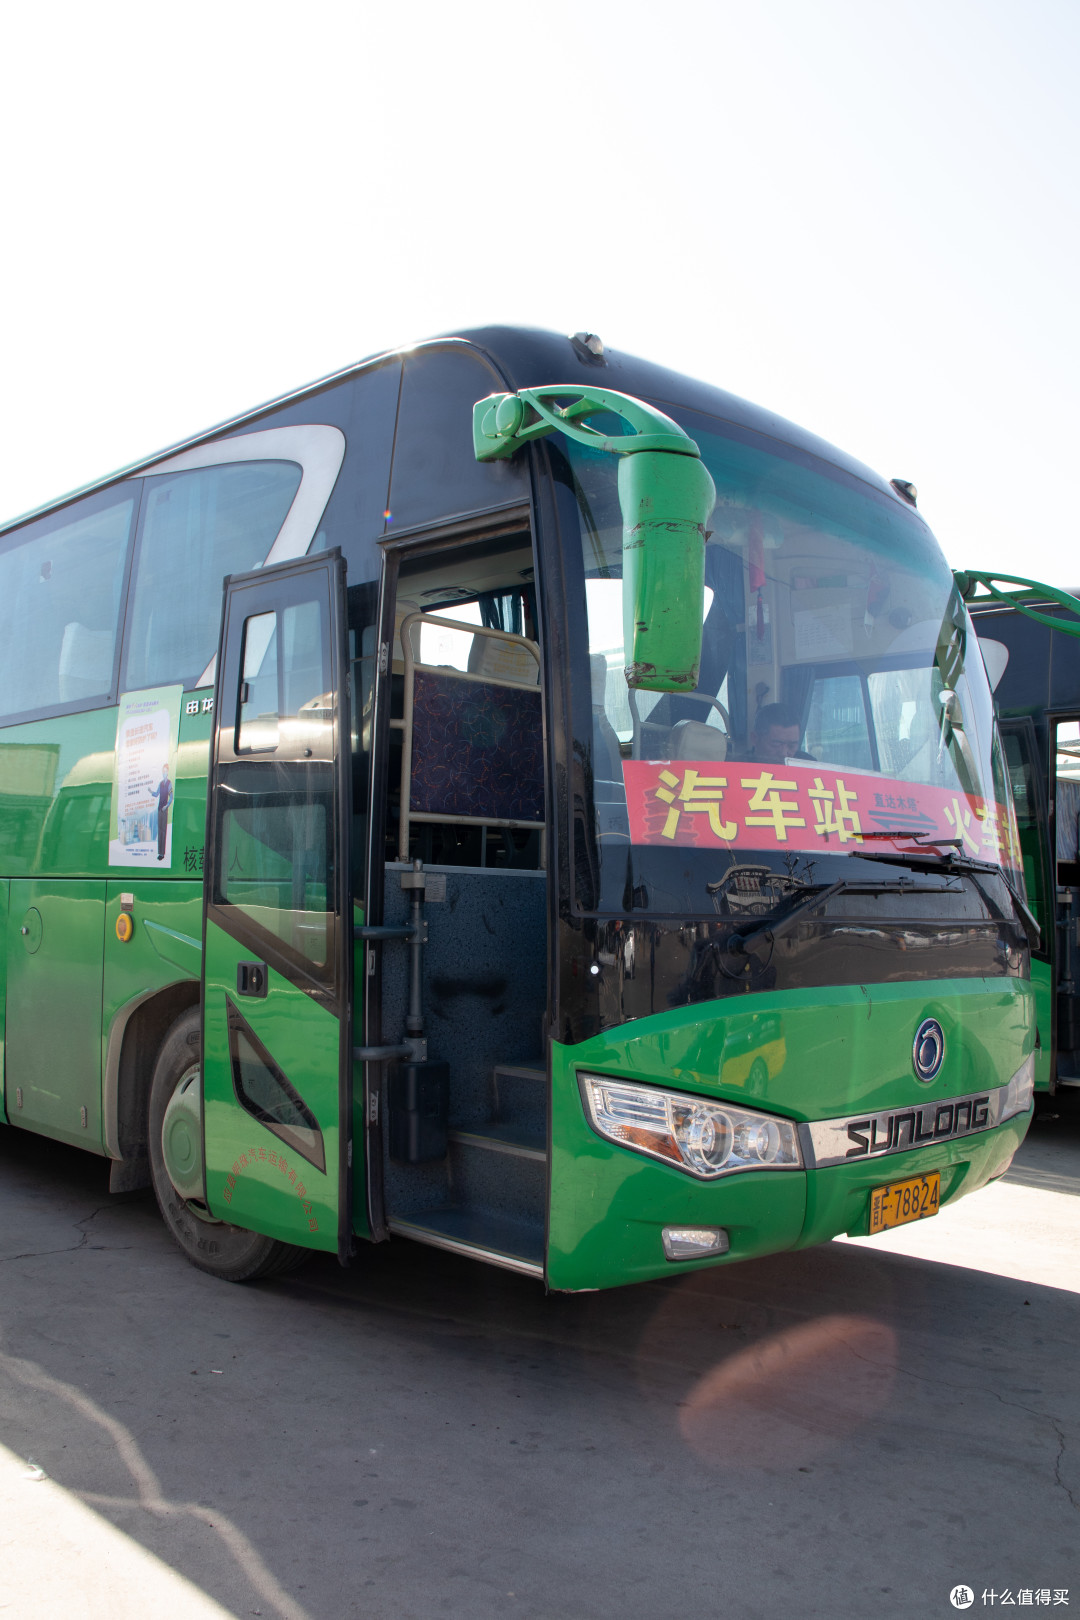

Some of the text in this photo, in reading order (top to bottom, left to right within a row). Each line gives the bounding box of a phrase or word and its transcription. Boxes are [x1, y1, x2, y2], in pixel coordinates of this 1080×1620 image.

[655, 769, 864, 844] 汽车站
[873, 792, 917, 812] 直达木塔
[846, 1096, 988, 1158] SUNLONG
